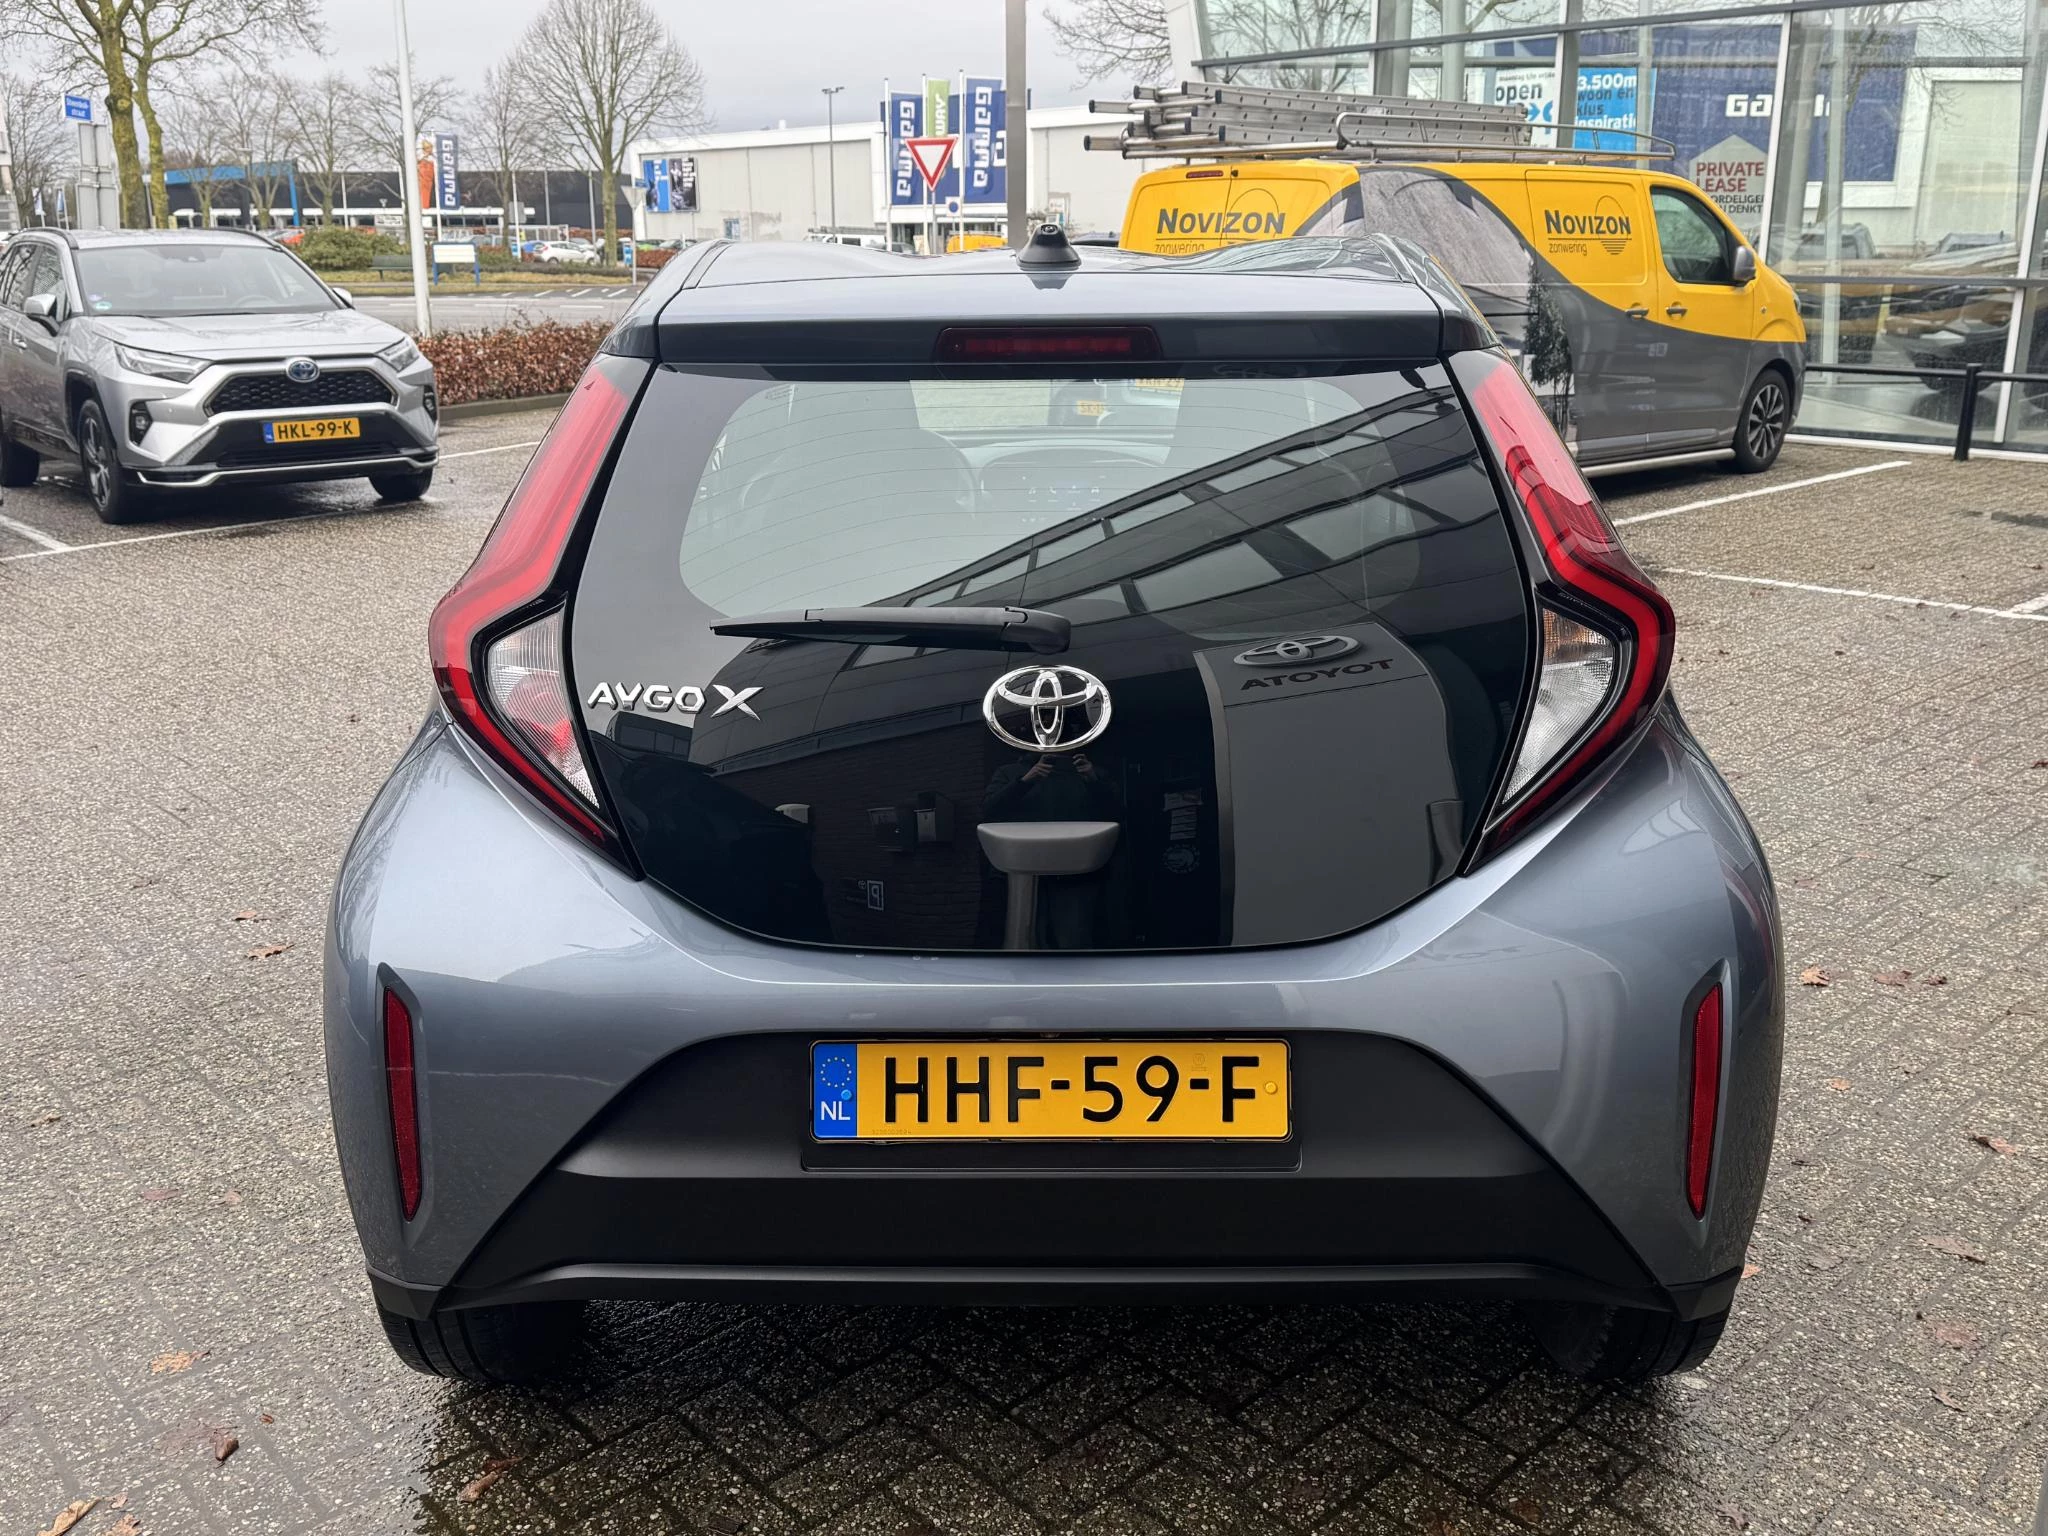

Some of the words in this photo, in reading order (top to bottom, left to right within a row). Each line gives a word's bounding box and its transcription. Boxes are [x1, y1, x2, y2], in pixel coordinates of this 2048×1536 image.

[1496, 83, 1542, 105] open
[1574, 113, 1637, 129] inspirati
[1696, 162, 1765, 177] PRIVATE
[1696, 178, 1747, 192] LEASE
[1729, 205, 1762, 214] DENKT
[1155, 241, 1205, 254] zonwering
[1549, 241, 1588, 256] zonwering
[277, 420, 353, 439] HKL-99-K
[587, 682, 706, 715] AYGO
[710, 684, 765, 721] X
[820, 1101, 851, 1121] NL
[884, 1055, 1260, 1123] HHF-59-F
